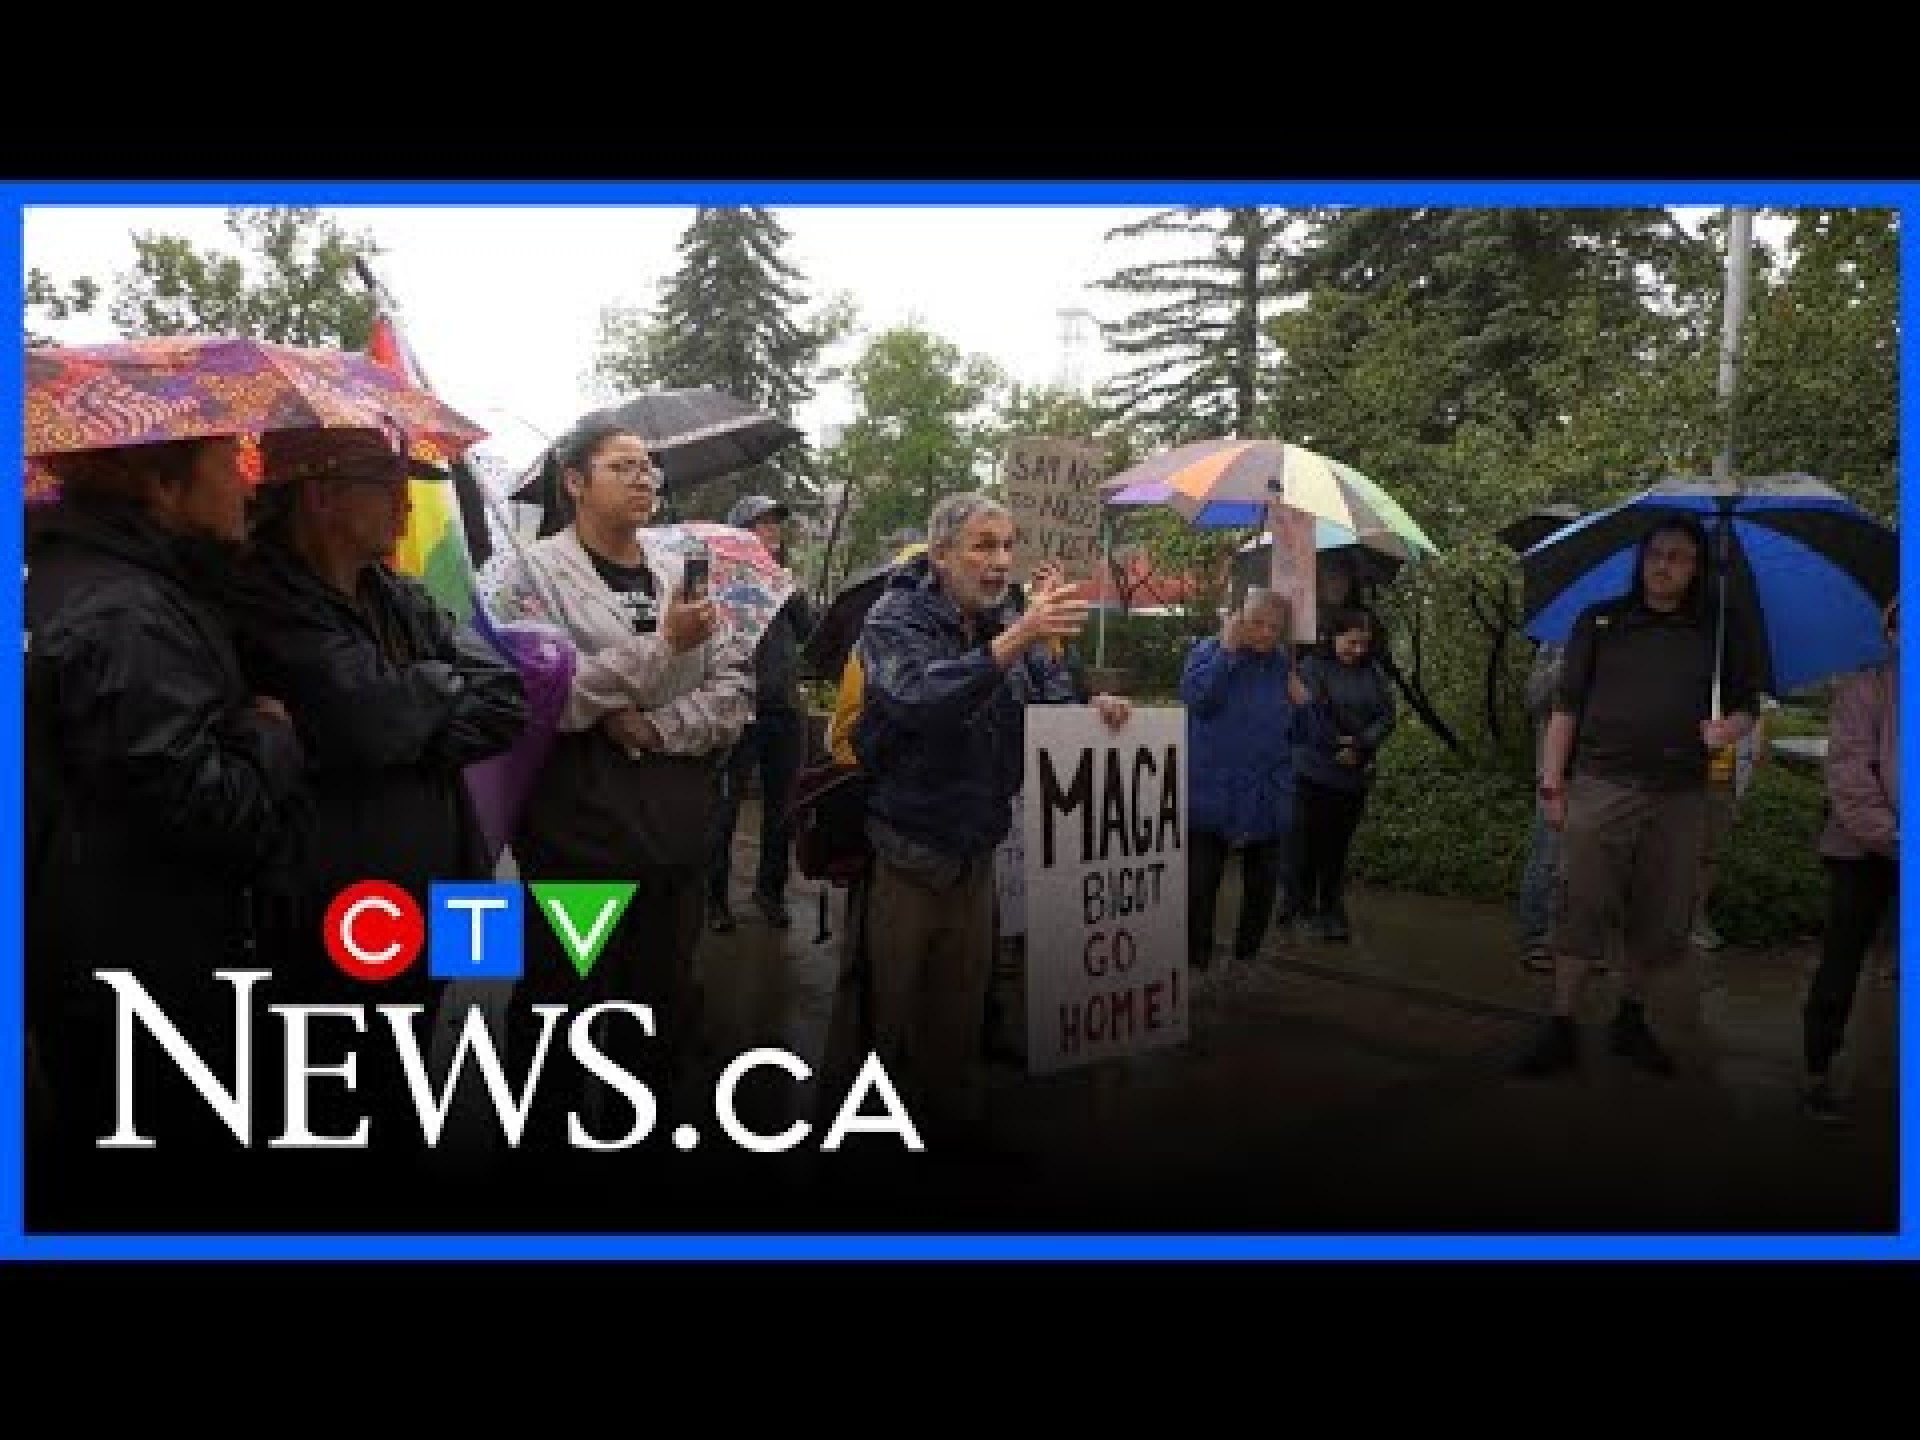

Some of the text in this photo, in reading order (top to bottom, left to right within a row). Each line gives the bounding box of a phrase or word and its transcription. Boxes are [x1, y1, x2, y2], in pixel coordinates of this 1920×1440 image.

[1011, 451, 1060, 484] SAY
[1036, 744, 1180, 868] MAGA
[1083, 860, 1164, 928] BIGOT
[1083, 928, 1136, 977] GO
[1059, 967, 1181, 1055] HOME!
